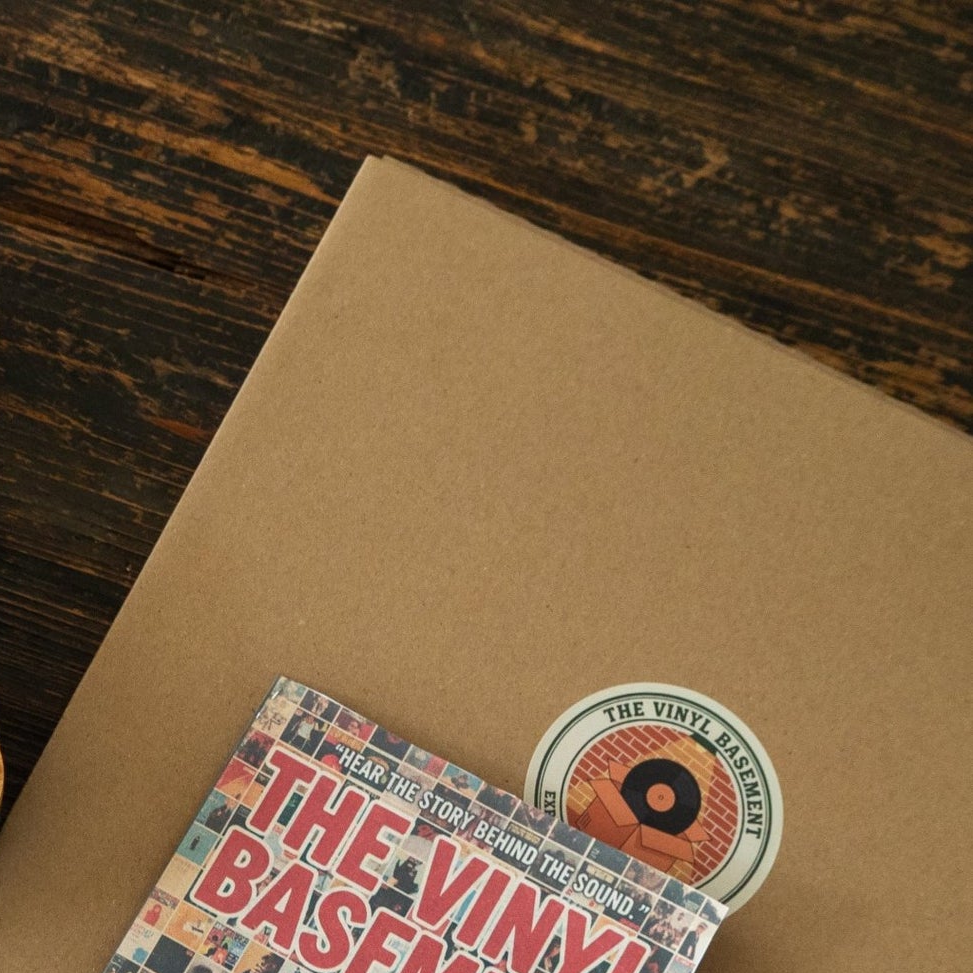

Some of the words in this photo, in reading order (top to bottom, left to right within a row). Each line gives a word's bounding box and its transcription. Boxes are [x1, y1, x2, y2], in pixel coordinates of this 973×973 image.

[244, 746, 415, 895] THE
[385, 771, 422, 800] THE
[418, 785, 476, 827] STORY
[473, 818, 538, 867] BEHIND
[538, 853, 575, 885] THE
[603, 701, 645, 723] THE
[653, 701, 711, 735] VINYL
[713, 731, 764, 840] BASEMENT
